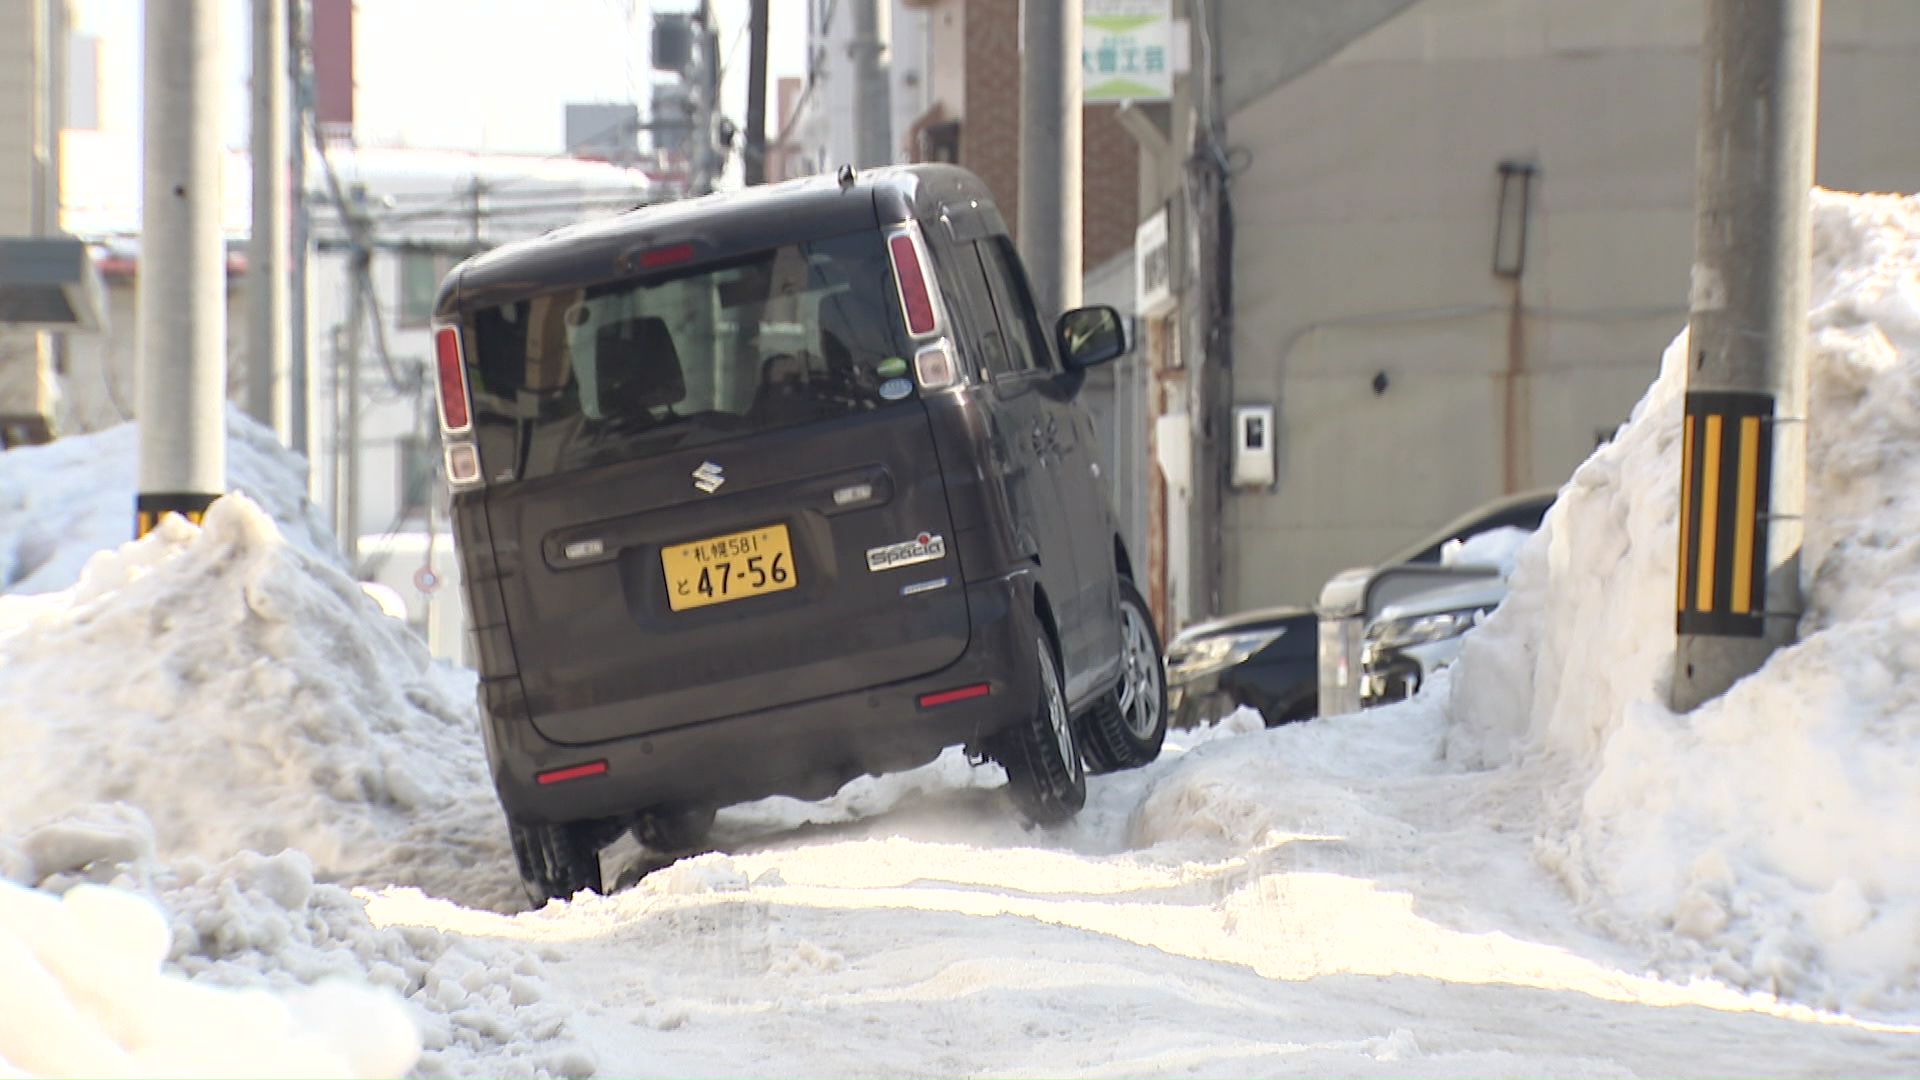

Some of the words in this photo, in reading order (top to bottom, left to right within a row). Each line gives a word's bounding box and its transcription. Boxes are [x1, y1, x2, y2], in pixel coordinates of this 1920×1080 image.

[870, 534, 941, 565] Spacia
[677, 579, 691, 595] と
[698, 552, 787, 597] 47-56
